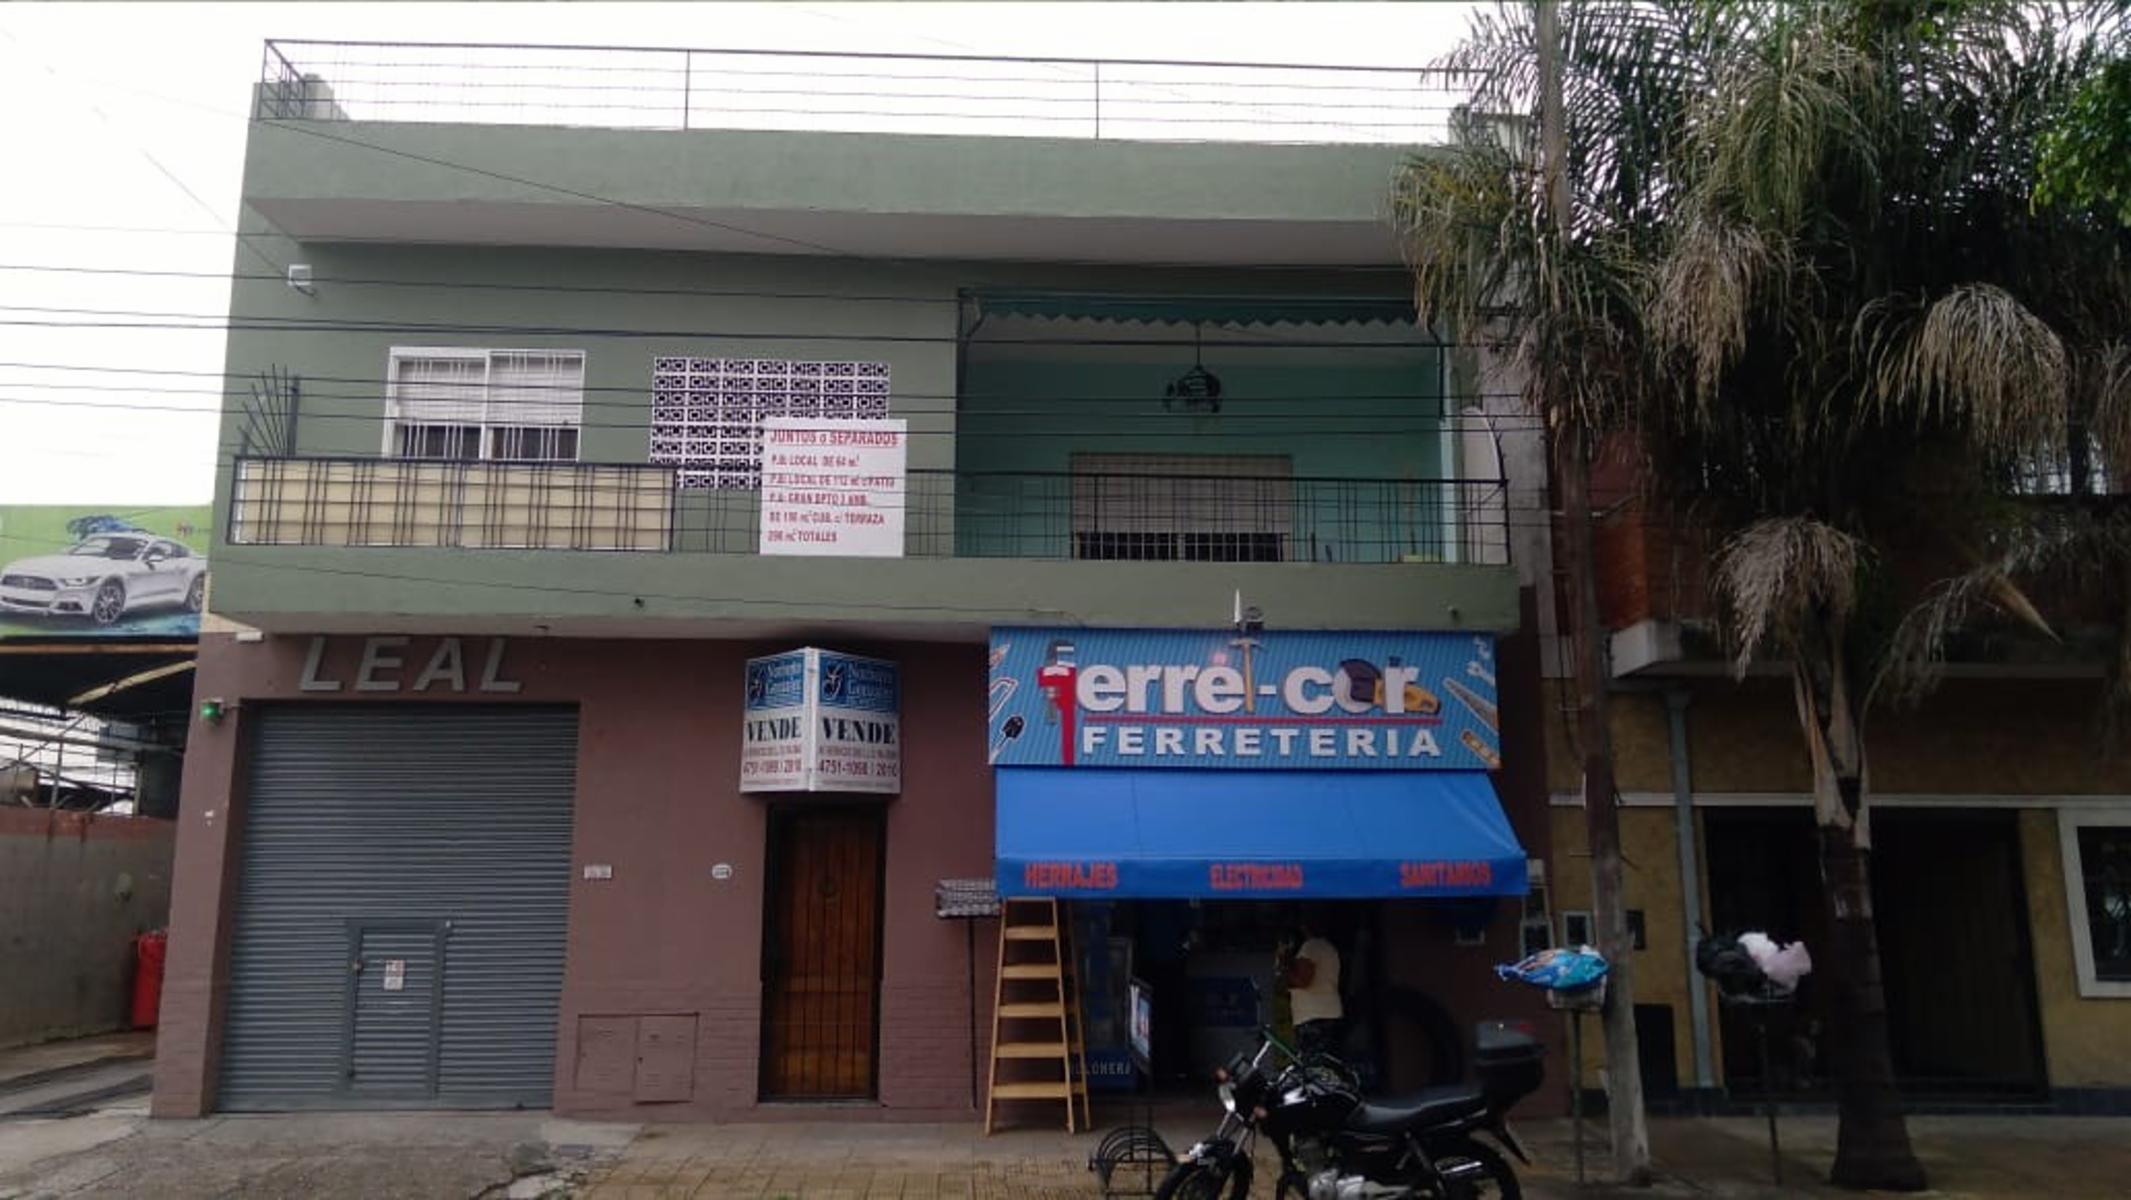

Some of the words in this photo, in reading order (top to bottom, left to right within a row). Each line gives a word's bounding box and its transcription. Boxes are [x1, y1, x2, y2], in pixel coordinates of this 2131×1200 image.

[770, 430, 816, 443] JUNTOS
[830, 430, 898, 446] SEPARADOS
[789, 454, 818, 467] LOCAL
[788, 474, 816, 486] LOCAL
[844, 512, 885, 526] TERRAZA
[798, 530, 838, 543] TOTALES
[299, 635, 523, 694] LEAL
[747, 716, 801, 742] VENDE
[823, 717, 896, 745] VENDE
[1083, 726, 1442, 759] FERRETERIA
[1024, 863, 1118, 889] HERRAJES
[1210, 863, 1304, 890] ELECTRICIDAD
[1400, 862, 1493, 888] SANITARIOS
